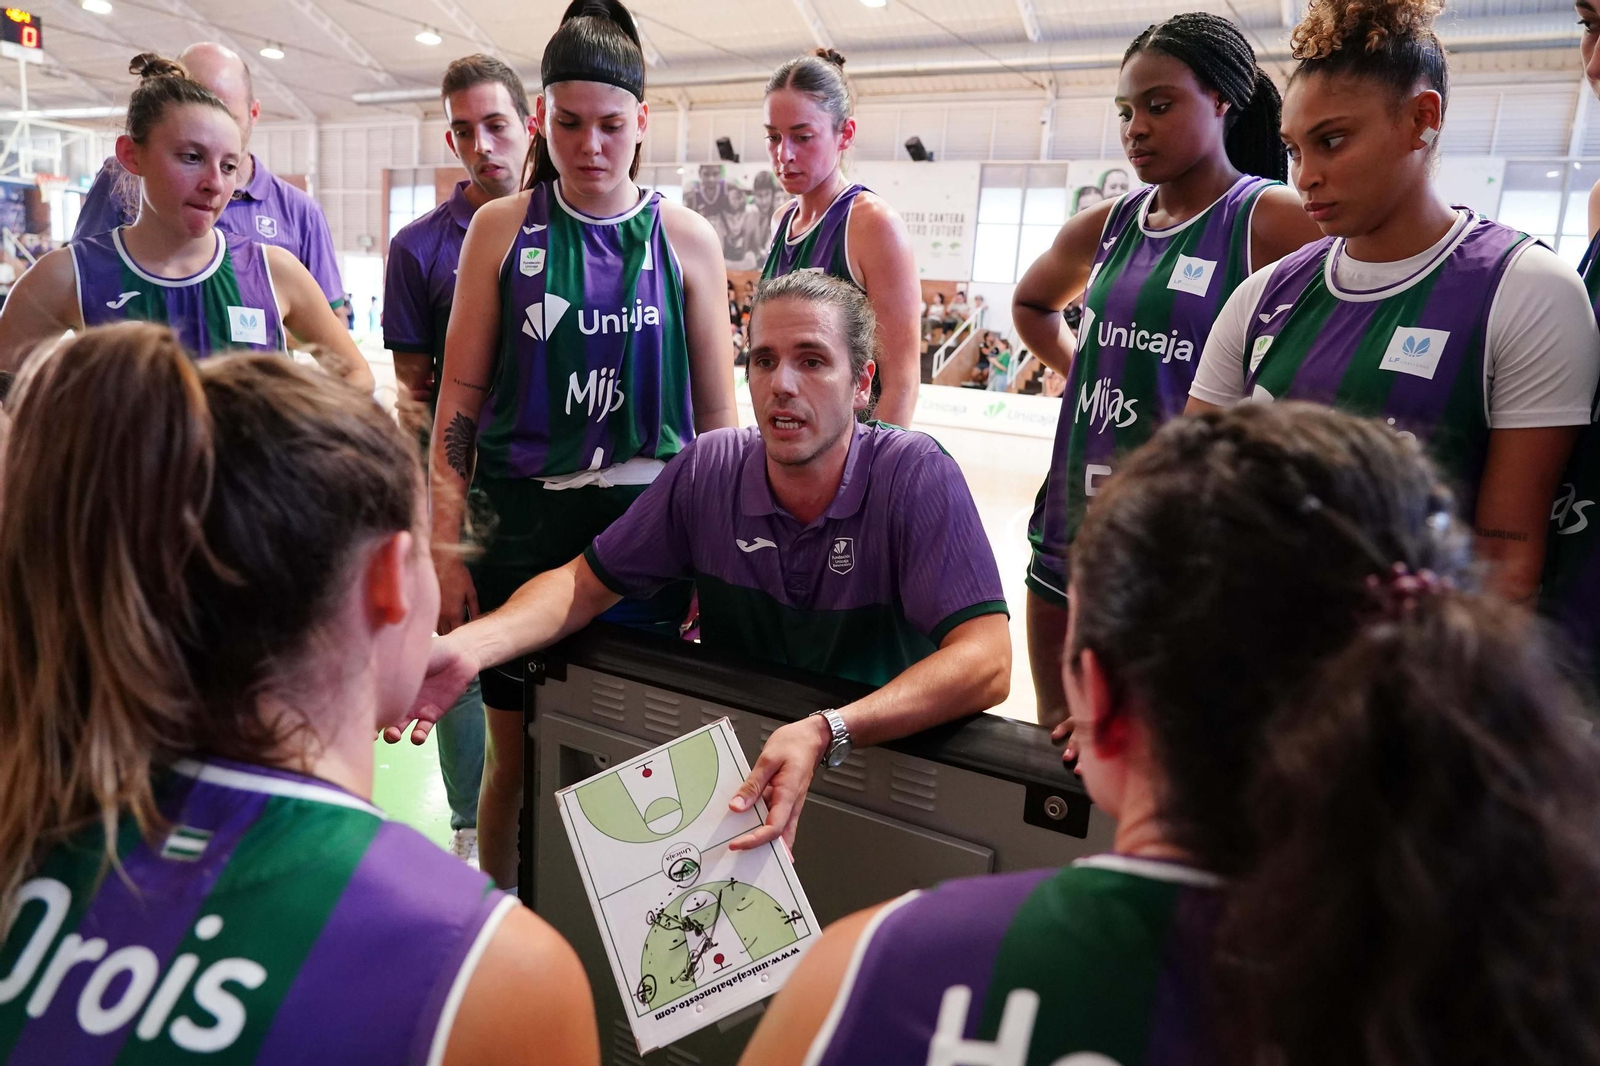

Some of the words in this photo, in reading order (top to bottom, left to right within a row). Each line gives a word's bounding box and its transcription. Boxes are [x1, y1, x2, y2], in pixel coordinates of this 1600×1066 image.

[22, 26, 37, 47] 0
[929, 212, 965, 224] CANTERA
[578, 299, 660, 335] Unija
[1097, 321, 1194, 364] Unicaja
[565, 367, 625, 423] Mijs
[1075, 377, 1138, 434] Mijas
[1483, 528, 1528, 542] SURRENDER
[665, 847, 692, 862] Unicaja
[654, 947, 800, 1022] www.unicajabaloncesto.com
